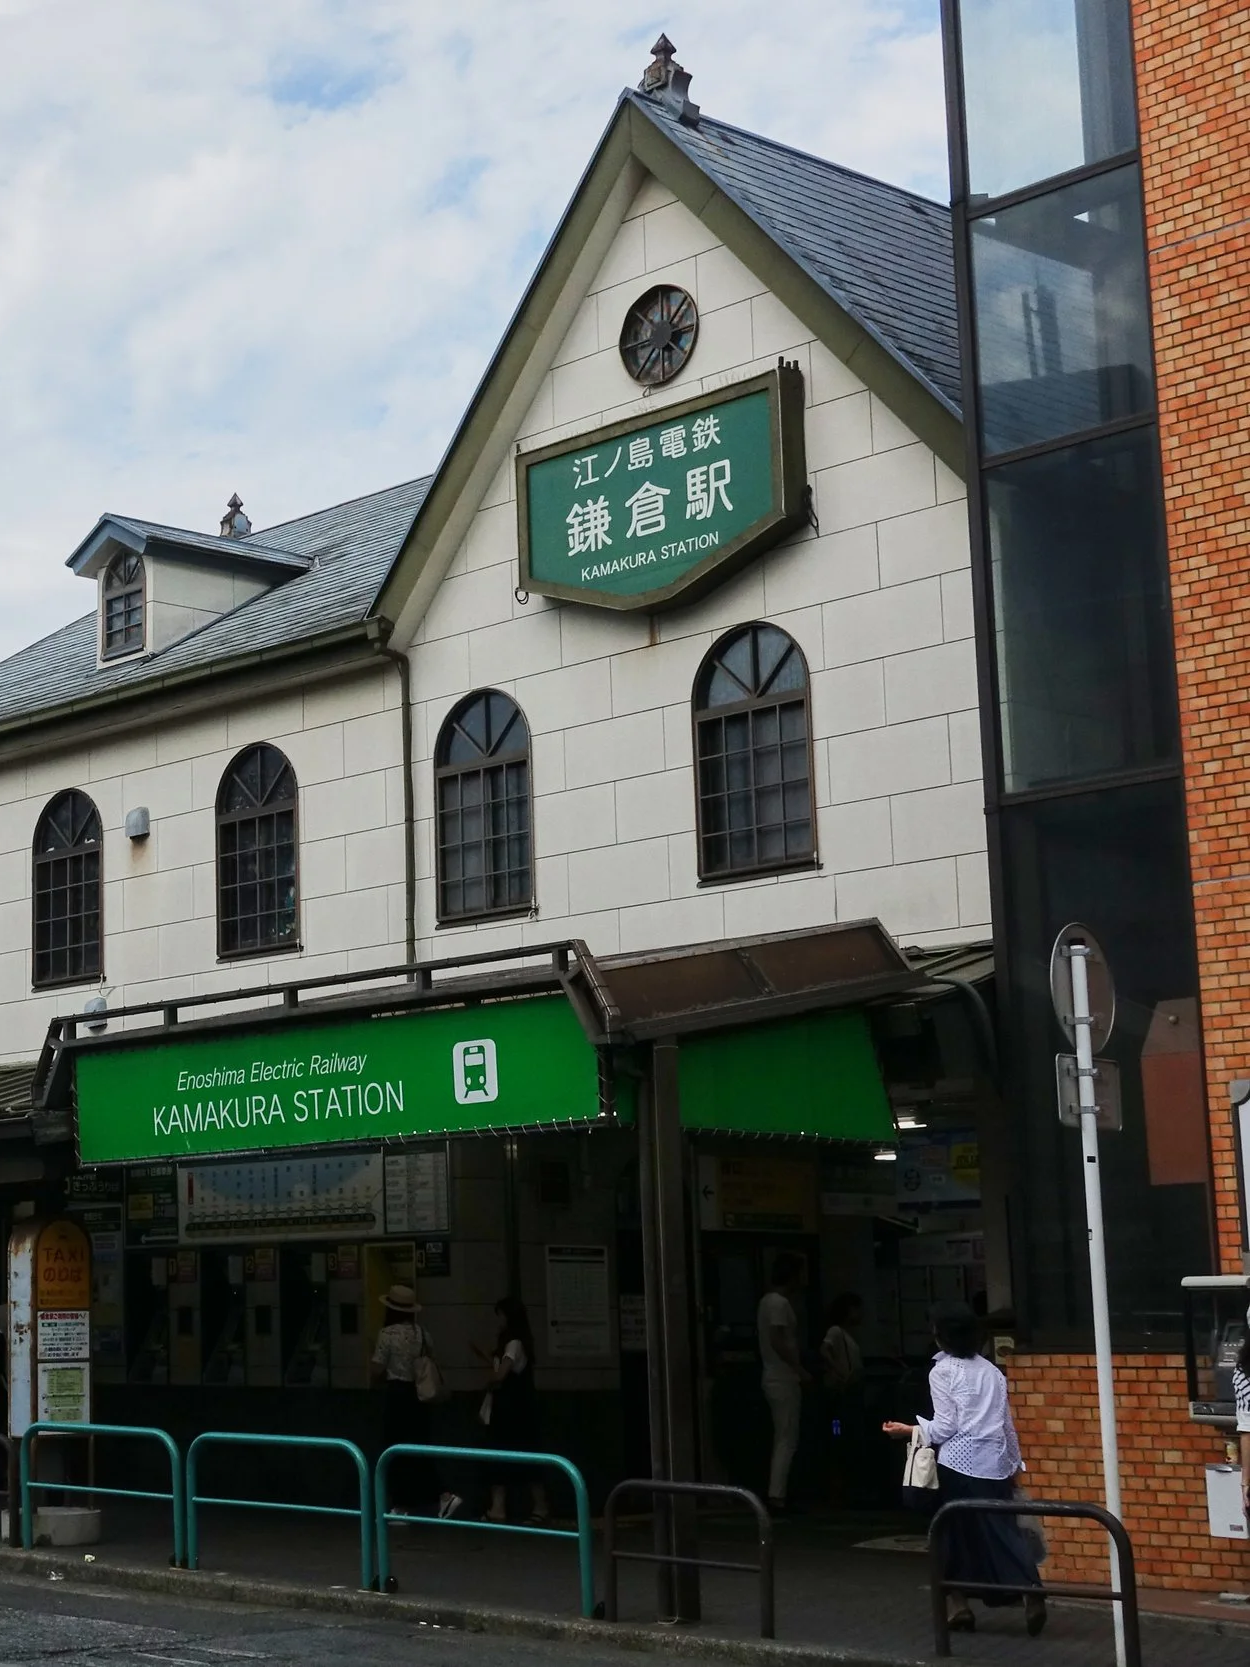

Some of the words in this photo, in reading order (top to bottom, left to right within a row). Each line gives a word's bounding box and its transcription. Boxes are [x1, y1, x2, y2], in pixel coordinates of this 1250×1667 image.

[572, 413, 722, 490] 江ノ島電鉄
[565, 458, 734, 557] 鎌倉駅
[580, 549, 657, 582] KAMAKURA
[660, 530, 720, 560] STATION
[176, 1066, 246, 1092] Enoshima
[250, 1057, 305, 1083] Electric
[309, 1052, 368, 1076] Railway
[153, 1094, 286, 1136] KAMAKURA
[293, 1080, 405, 1123] STATION
[43, 1246, 85, 1263] TAXI
[43, 1266, 84, 1283] のりば
